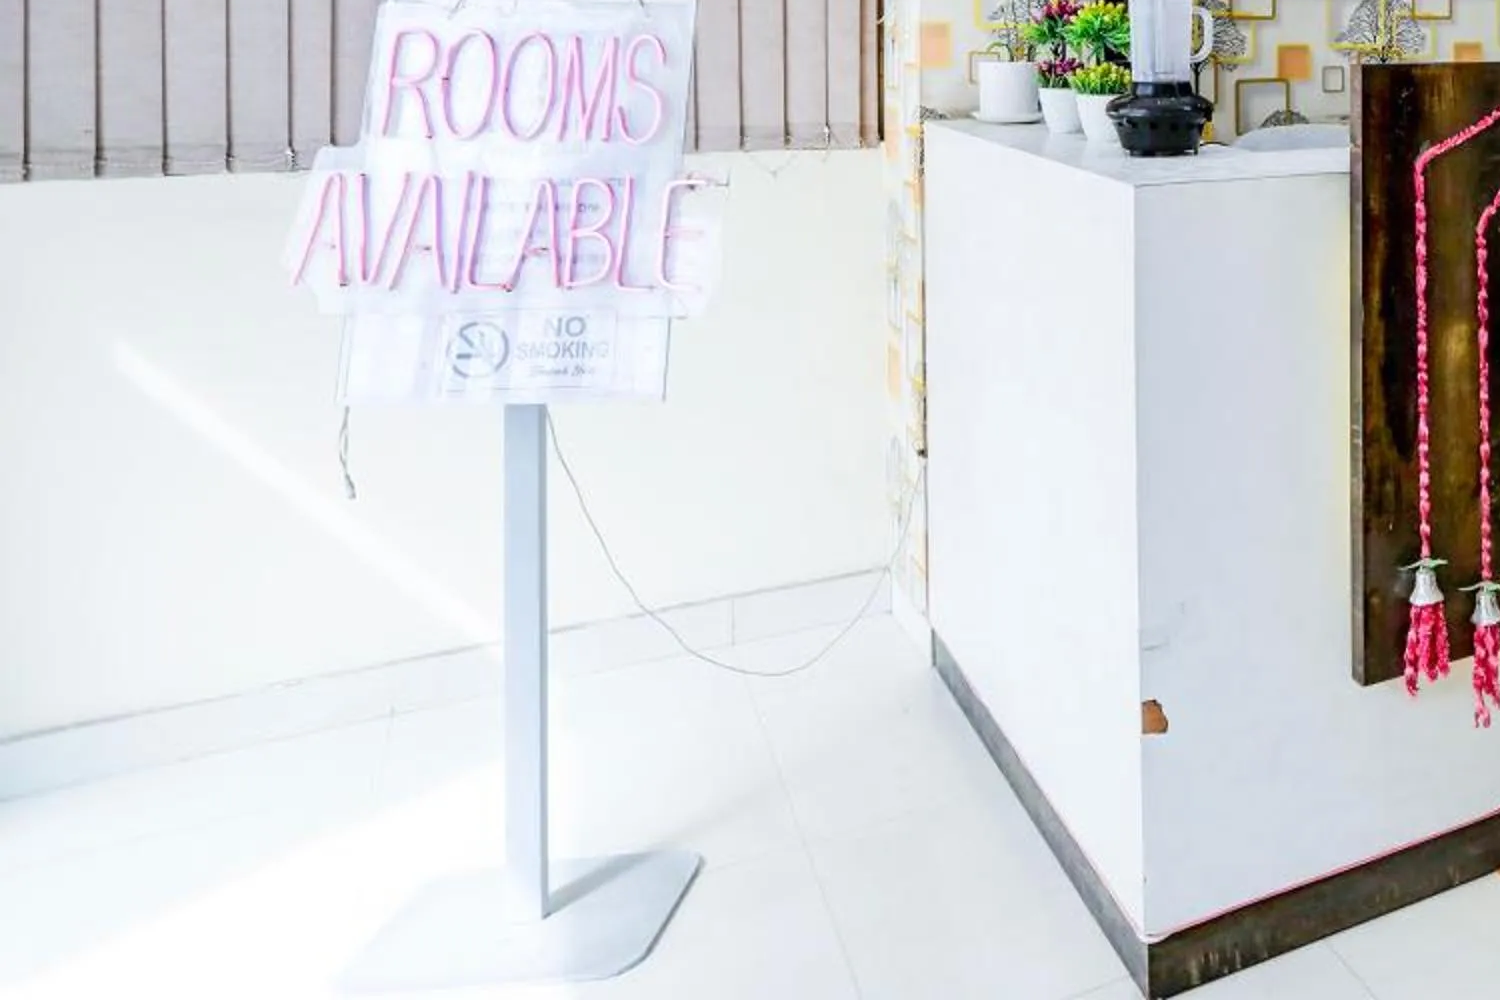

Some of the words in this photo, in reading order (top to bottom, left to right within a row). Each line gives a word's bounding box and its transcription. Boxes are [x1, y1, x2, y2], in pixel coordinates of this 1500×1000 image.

[381, 30, 667, 144] ROOMS
[290, 171, 708, 293] AVAILABLE
[515, 341, 608, 360] SMOKING
[543, 316, 585, 336] NO
